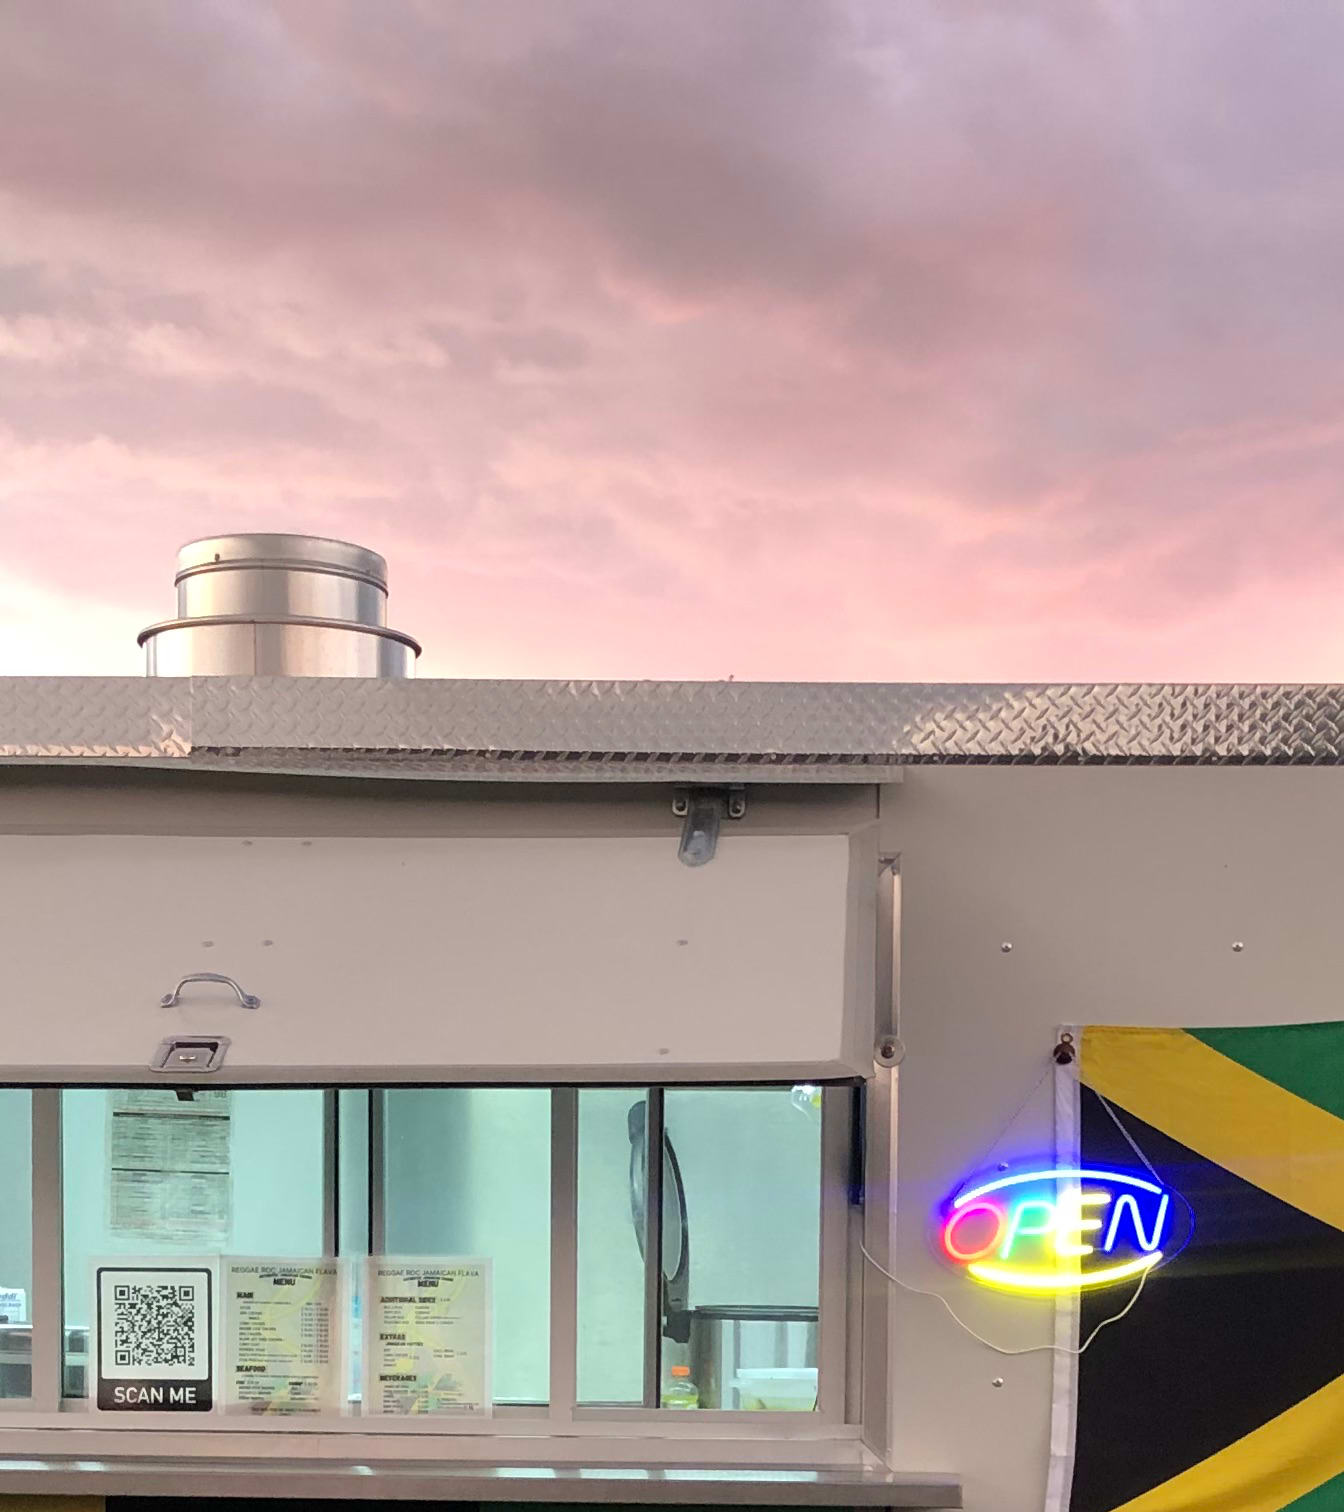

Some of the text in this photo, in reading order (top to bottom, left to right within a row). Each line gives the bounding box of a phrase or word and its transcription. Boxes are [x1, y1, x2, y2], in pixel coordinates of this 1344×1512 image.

[944, 1188, 1169, 1260] OPEN
[231, 1266, 259, 1274] REGGAE
[278, 1267, 314, 1275] JAMAICAN
[377, 1269, 404, 1277] REGGAE
[422, 1269, 457, 1277] JAMAICAN
[272, 1278, 296, 1286] MENU
[114, 1386, 197, 1404] SCAN ME
